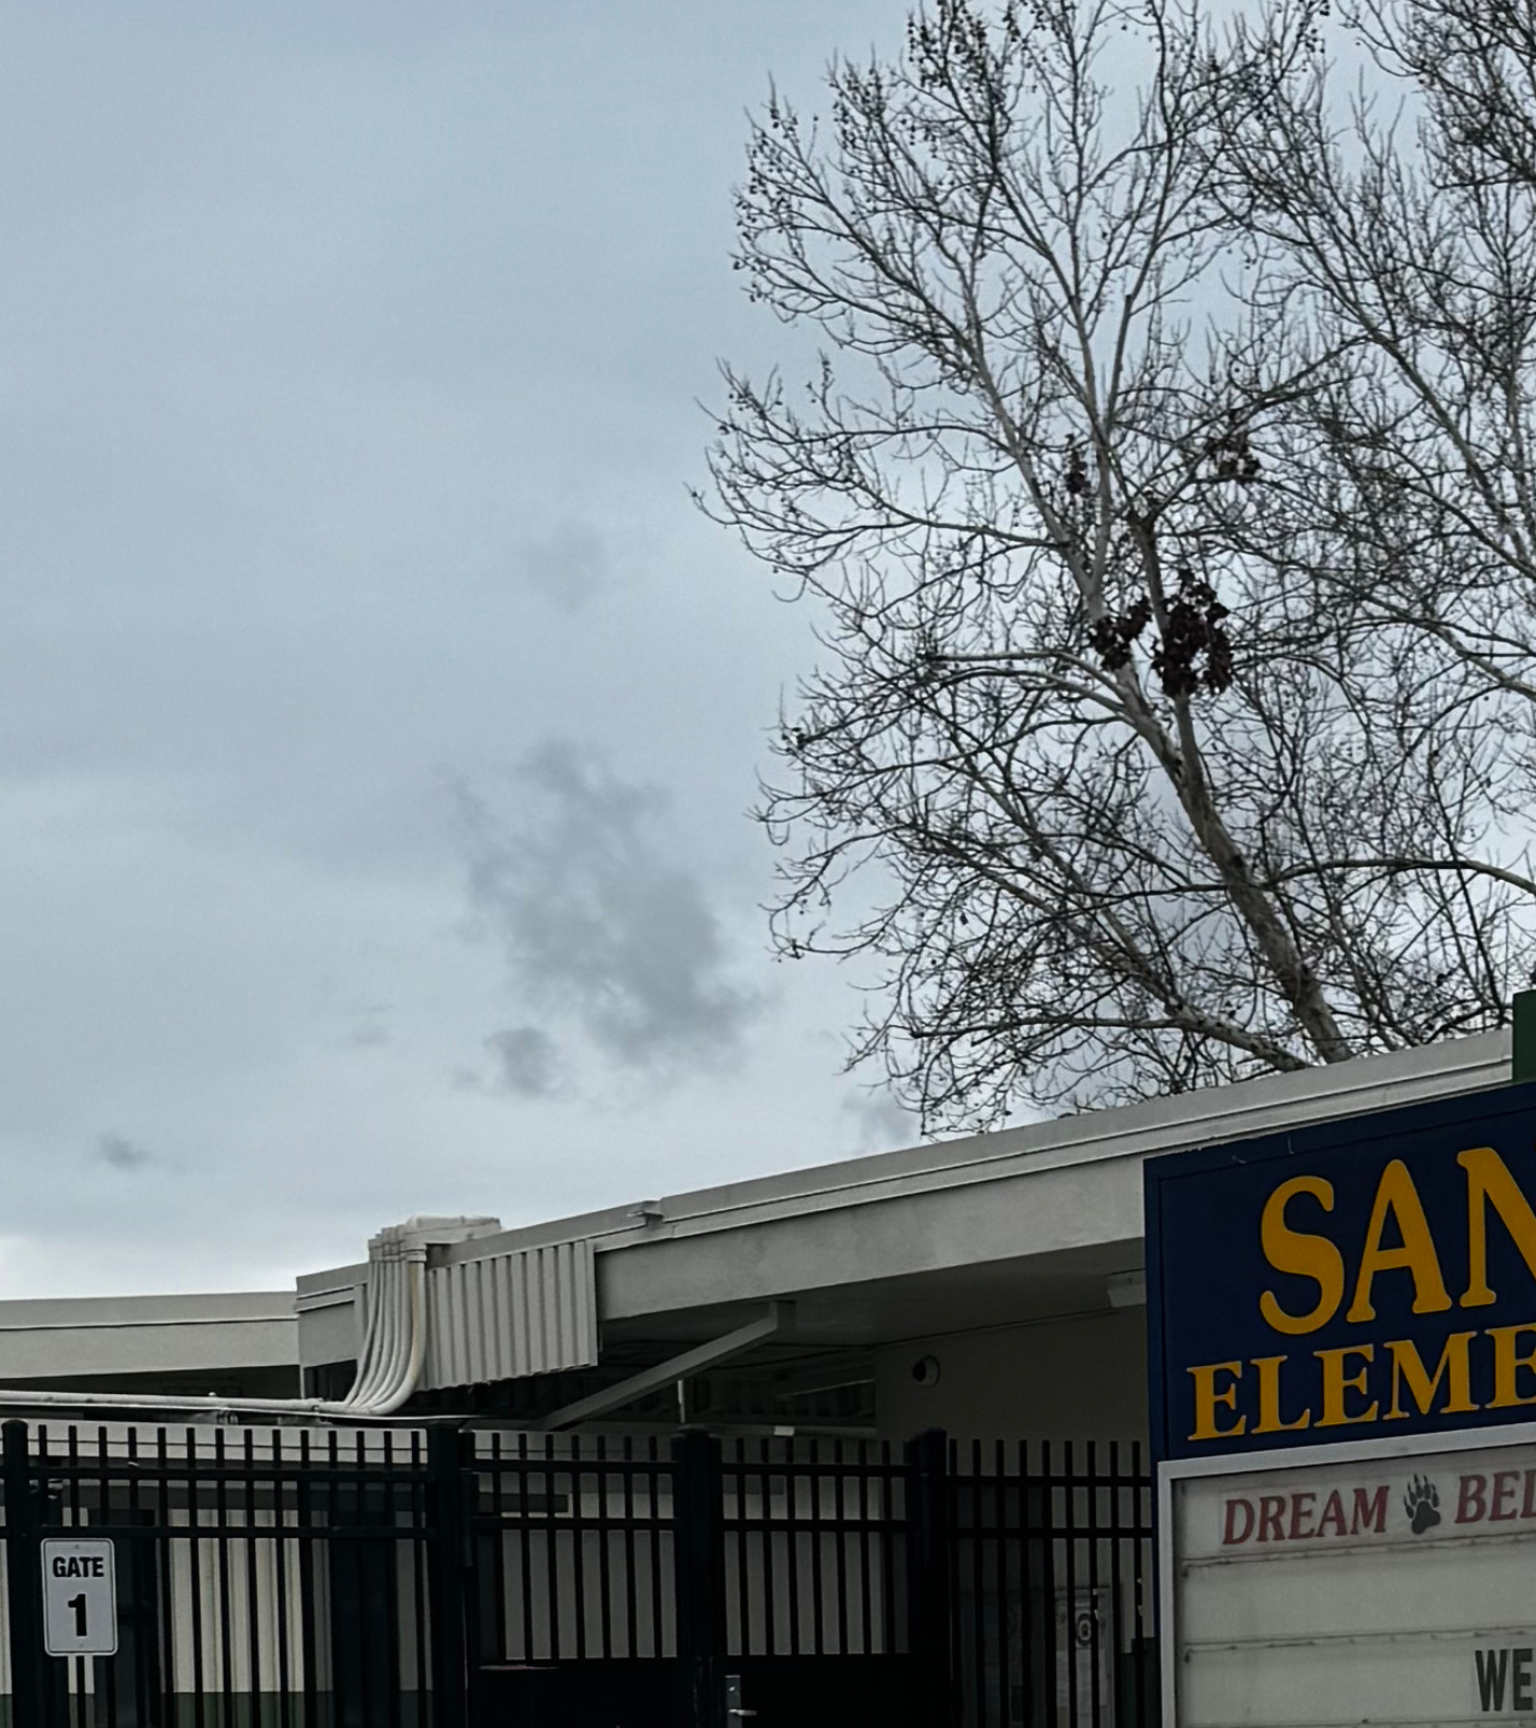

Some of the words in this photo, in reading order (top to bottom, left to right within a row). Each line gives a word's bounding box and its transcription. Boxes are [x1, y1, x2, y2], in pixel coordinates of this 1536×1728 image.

[1222, 1484, 1390, 1546] DREAM
[52, 1556, 105, 1578] GATE
[67, 1593, 88, 1637] 1
